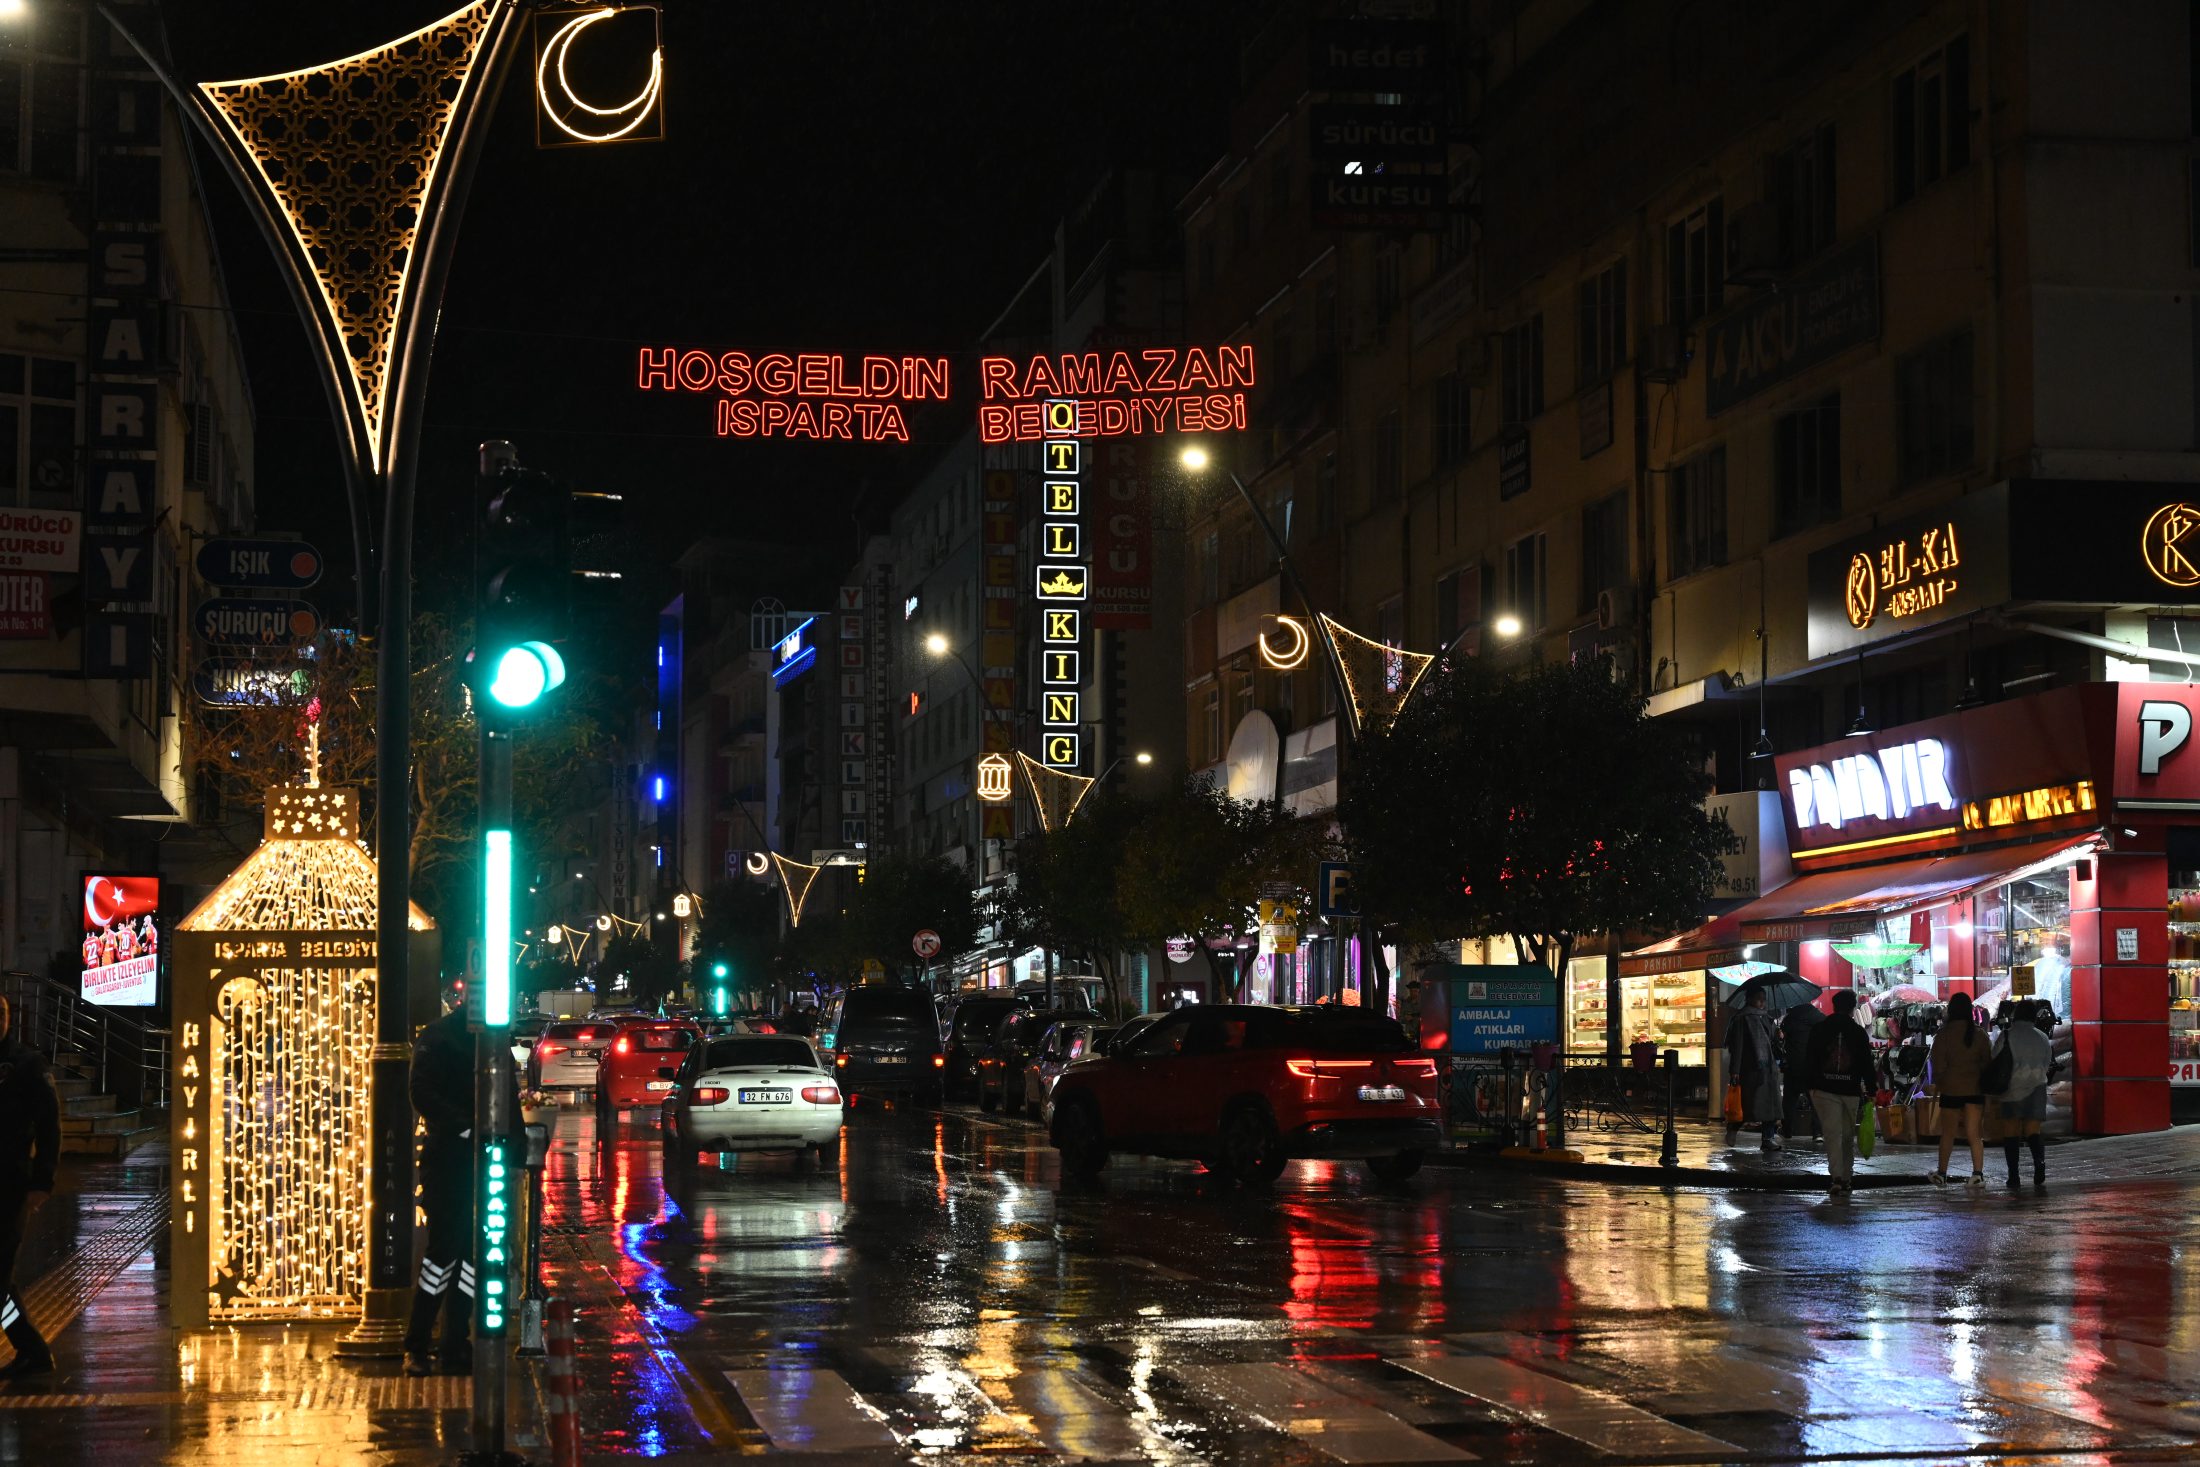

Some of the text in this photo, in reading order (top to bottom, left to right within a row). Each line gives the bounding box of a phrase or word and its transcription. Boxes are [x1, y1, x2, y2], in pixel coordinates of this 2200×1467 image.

[1328, 43, 1427, 67] hedef
[1323, 120, 1435, 145] sürücü
[1328, 178, 1431, 205] kursu
[981, 346, 1255, 399] RAMAZAN
[717, 400, 909, 440] ISPARTA
[1048, 402, 1076, 555] OTEL
[1096, 586, 1150, 599] KURSU
[1048, 612, 1076, 757] KING
[1789, 738, 1953, 830] PANAYIR
[1766, 923, 1804, 939] PANAYIR
[1644, 955, 1682, 972] PANAYIR
[1459, 1010, 1511, 1020] AMBALAJ
[1474, 1025, 1525, 1035] ATIKLARI
[2167, 1064, 2200, 1081] PA
[746, 1093, 790, 1102] 32 FN 676
[182, 1021, 200, 1233] HAYIRLI
